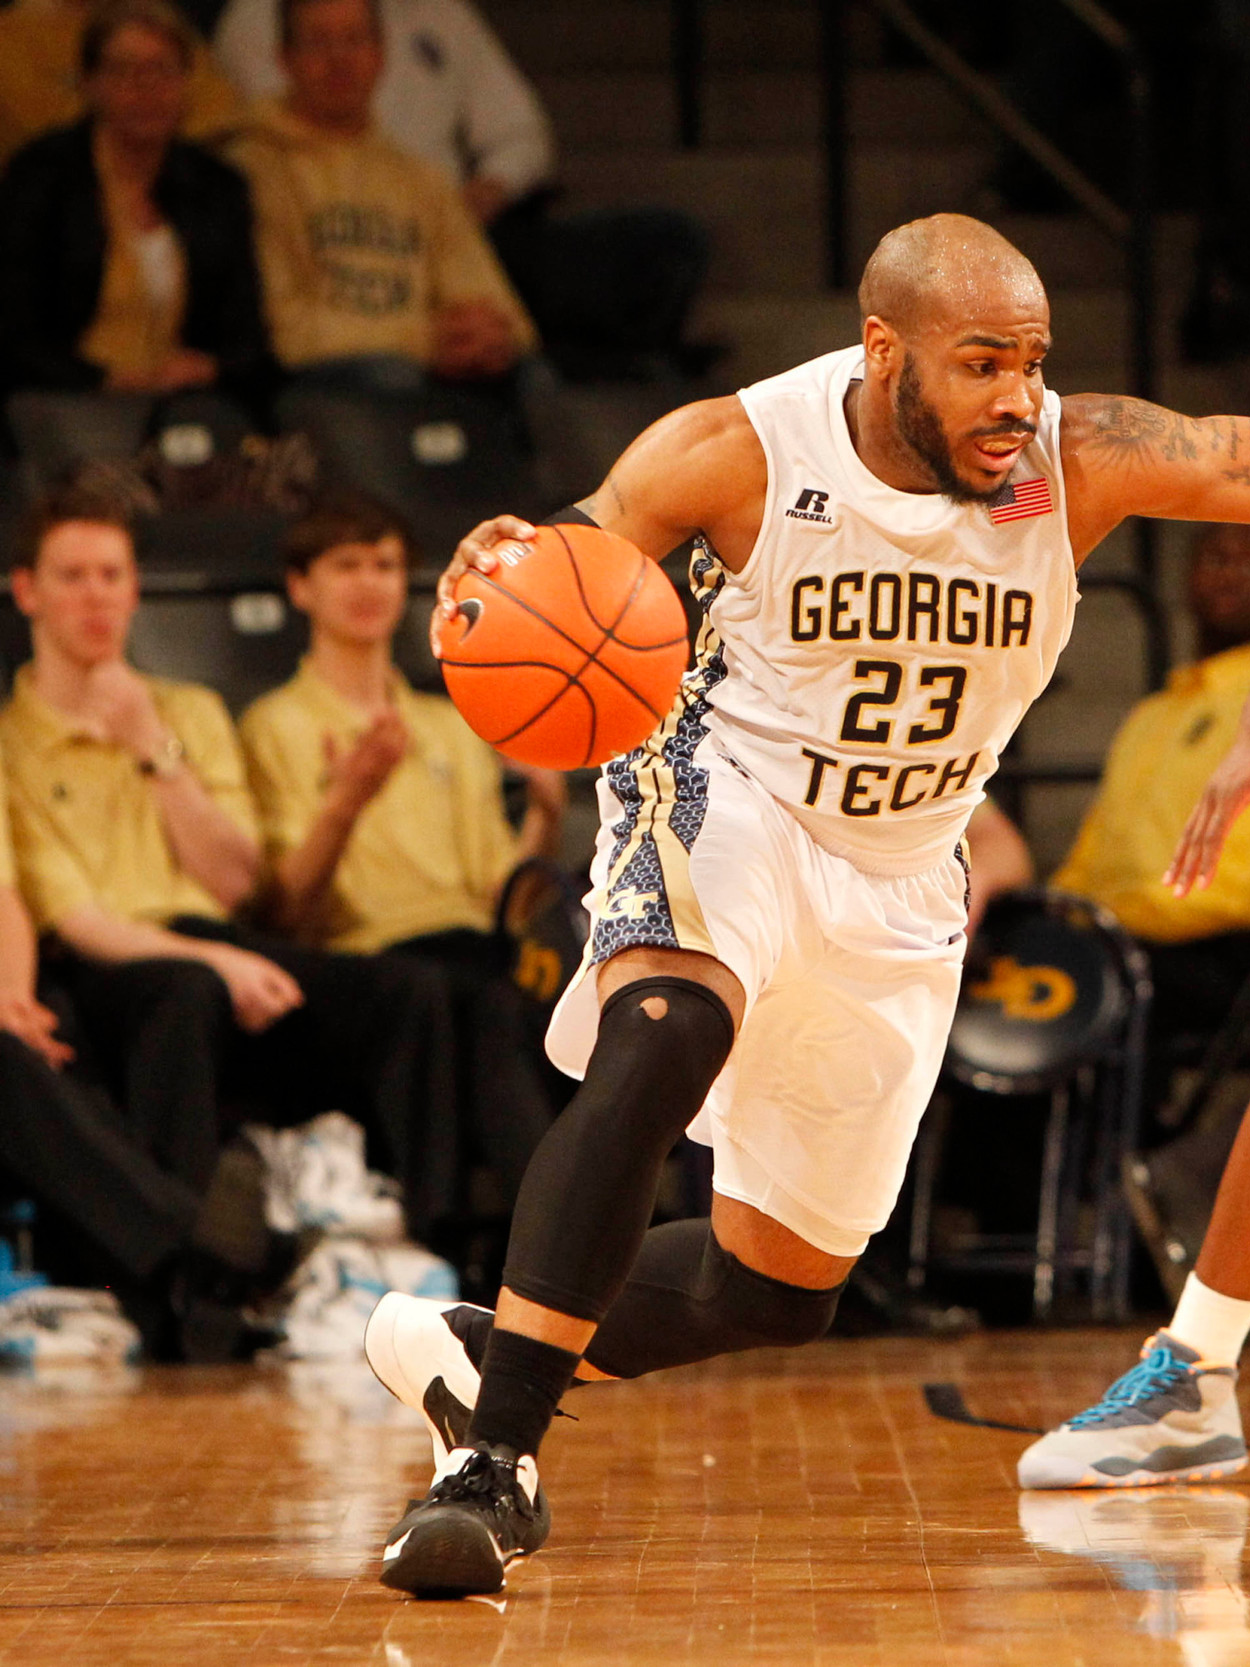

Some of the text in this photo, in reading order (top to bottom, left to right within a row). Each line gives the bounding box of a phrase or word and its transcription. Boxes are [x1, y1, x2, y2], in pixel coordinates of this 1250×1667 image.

[785, 509, 832, 525] RUSSELL
[790, 571, 1034, 648] GEORGIA
[839, 659, 967, 746] 23
[801, 748, 979, 817] TECH
